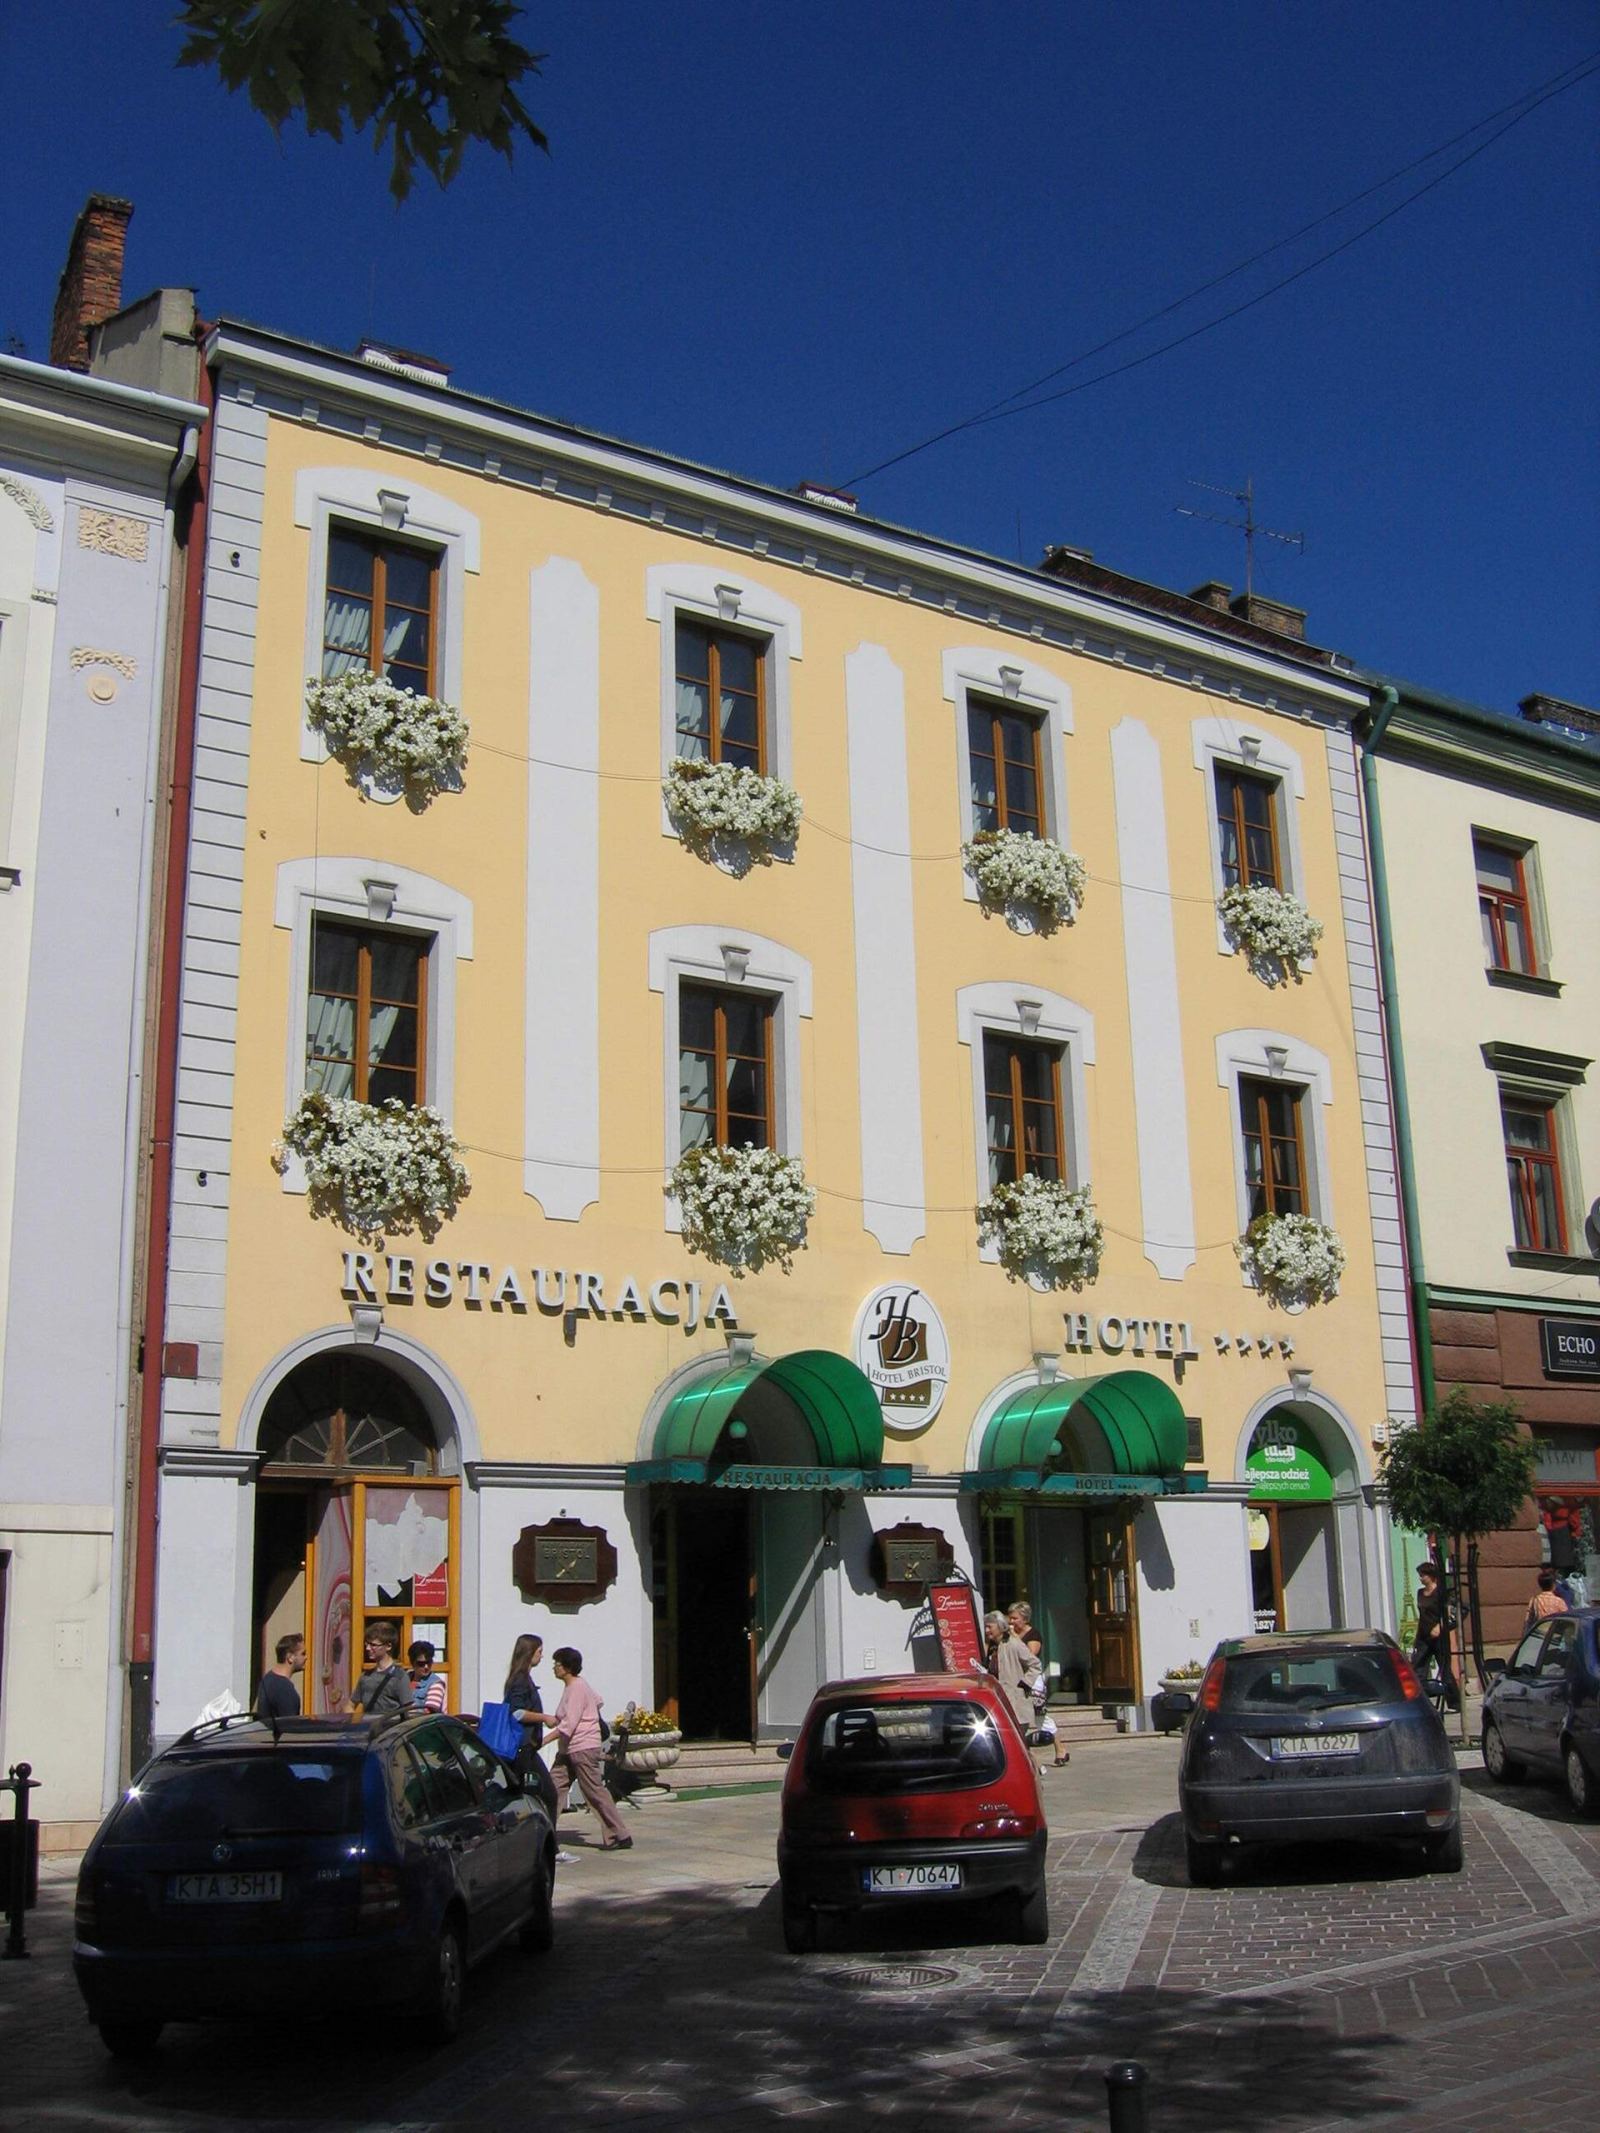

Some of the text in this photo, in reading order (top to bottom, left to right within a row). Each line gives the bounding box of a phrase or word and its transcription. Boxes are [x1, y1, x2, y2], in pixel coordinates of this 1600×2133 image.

[341, 1250, 740, 1330] RESTAURACJA
[1063, 1311, 1199, 1355] HOTEL
[1557, 1335, 1595, 1354] ECHO
[872, 1364, 947, 1384] HOTEL BRISTOL
[1252, 1420, 1297, 1448] ylko
[723, 1471, 832, 1486] RESTAURACJA
[1076, 1478, 1114, 1490] HOTEL
[1244, 1467, 1280, 1481] ajlepsza
[1280, 1734, 1357, 1753] KTA 16297
[178, 1873, 277, 1898] KTA 35H1
[872, 1865, 957, 1886] KT 70647
